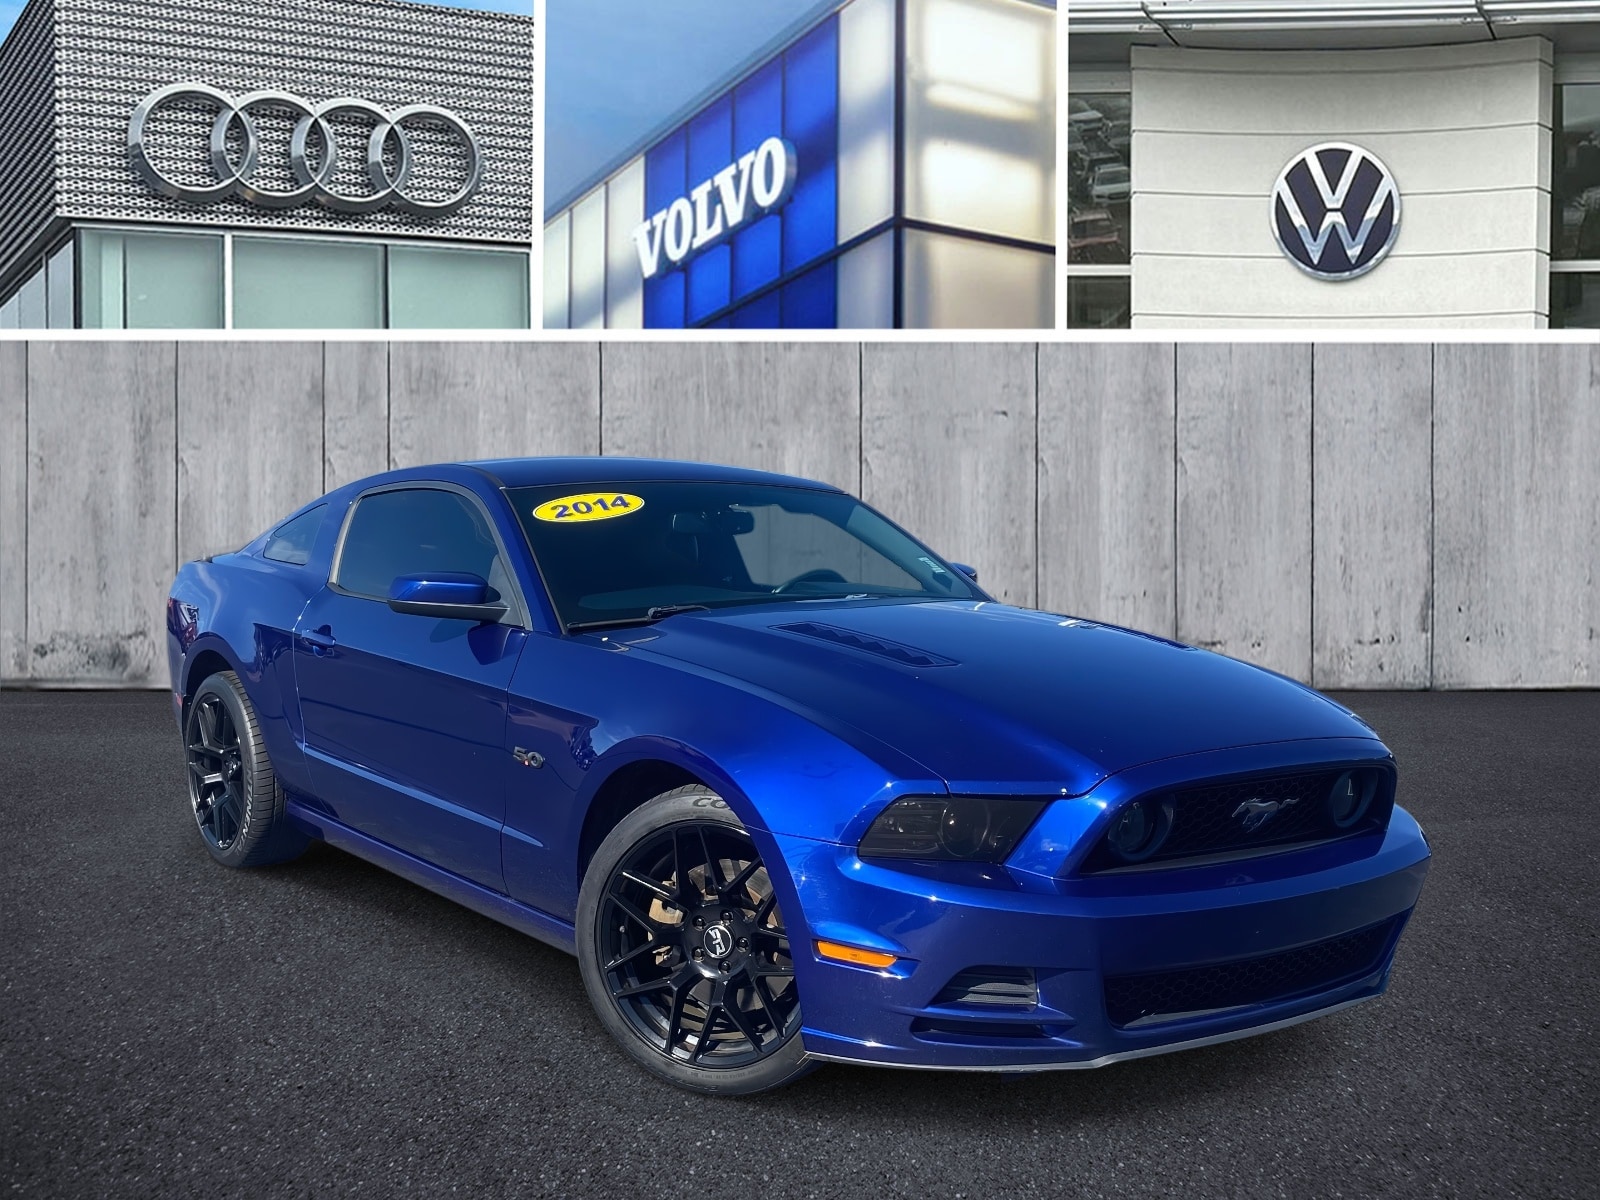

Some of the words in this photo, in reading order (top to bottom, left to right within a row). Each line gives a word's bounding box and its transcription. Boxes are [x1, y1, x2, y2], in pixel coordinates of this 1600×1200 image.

[633, 136, 790, 279] VOLVO
[1272, 144, 1398, 272] VW
[550, 495, 630, 519] 2014
